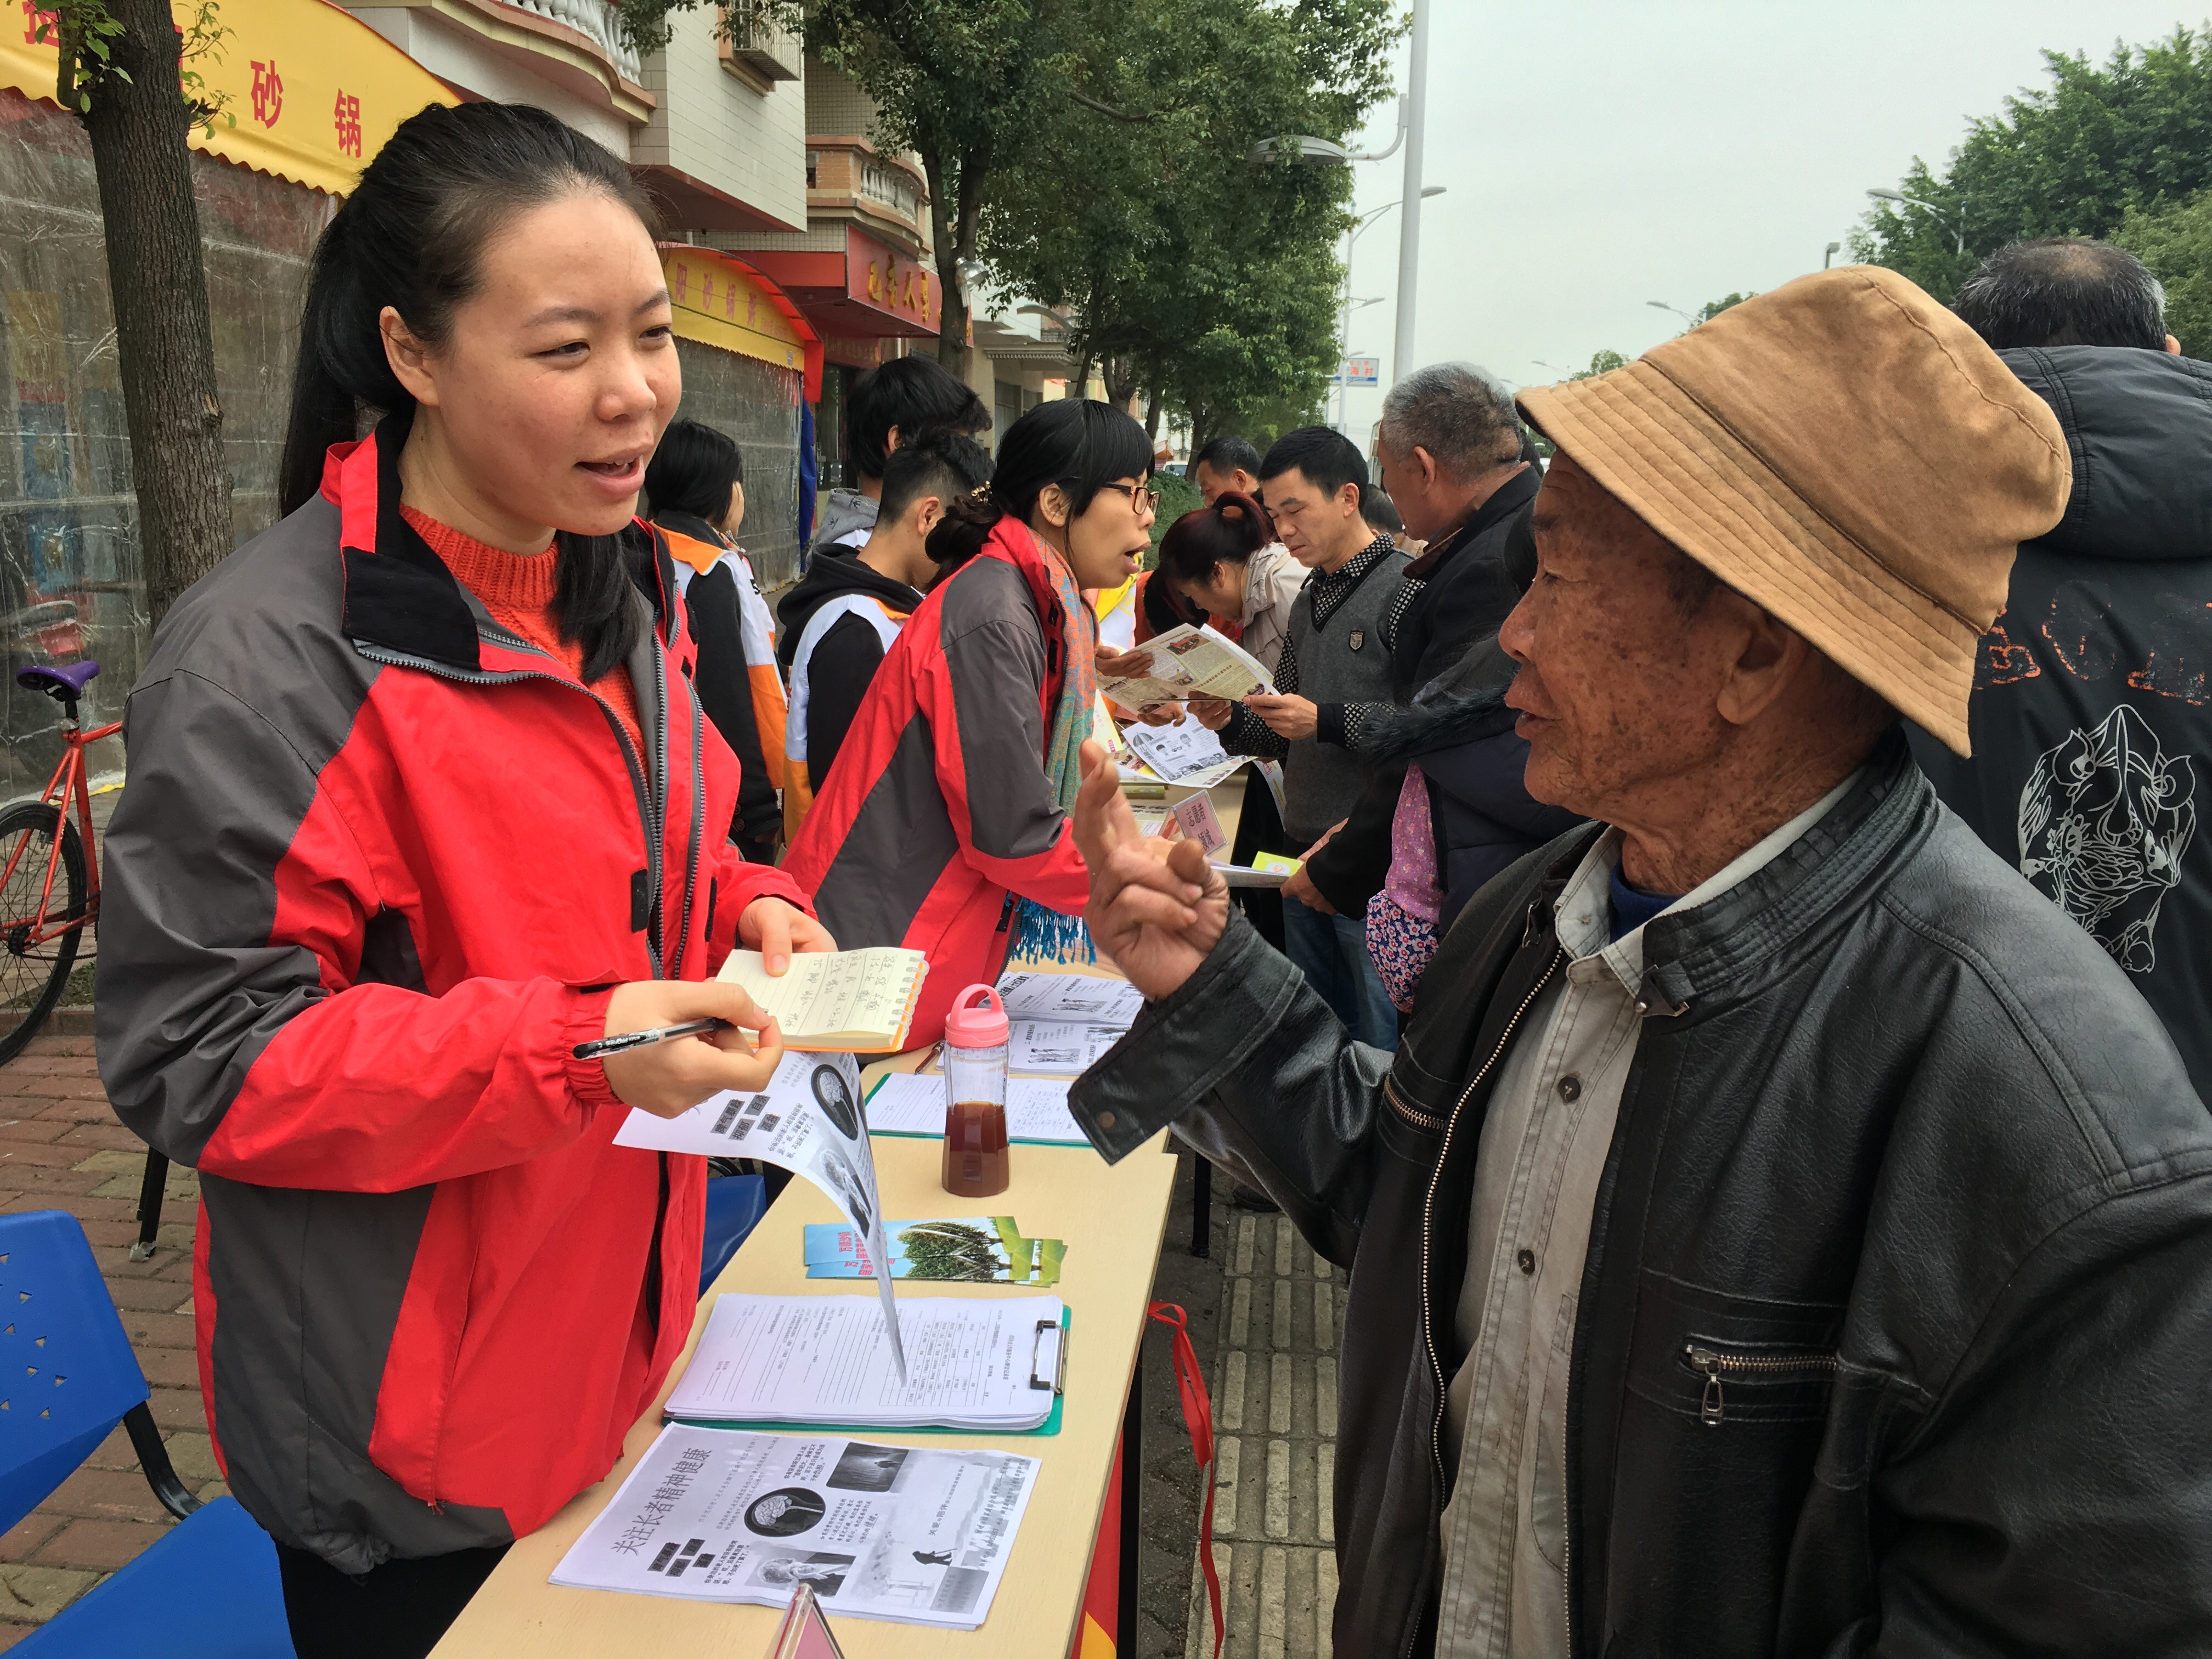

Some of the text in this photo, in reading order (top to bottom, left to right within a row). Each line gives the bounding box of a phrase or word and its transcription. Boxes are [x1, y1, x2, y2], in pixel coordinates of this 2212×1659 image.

[1186, 802, 1206, 827] 志愿者
[751, 1094, 768, 1111] 自杀
[715, 1098, 744, 1134] 脾气暴躁
[732, 1120, 750, 1141] 抑郁
[607, 1447, 714, 1556] 关注长者精神健康
[649, 1542, 679, 1571] 脾气暴躁
[667, 1560, 687, 1576] 抑郁
